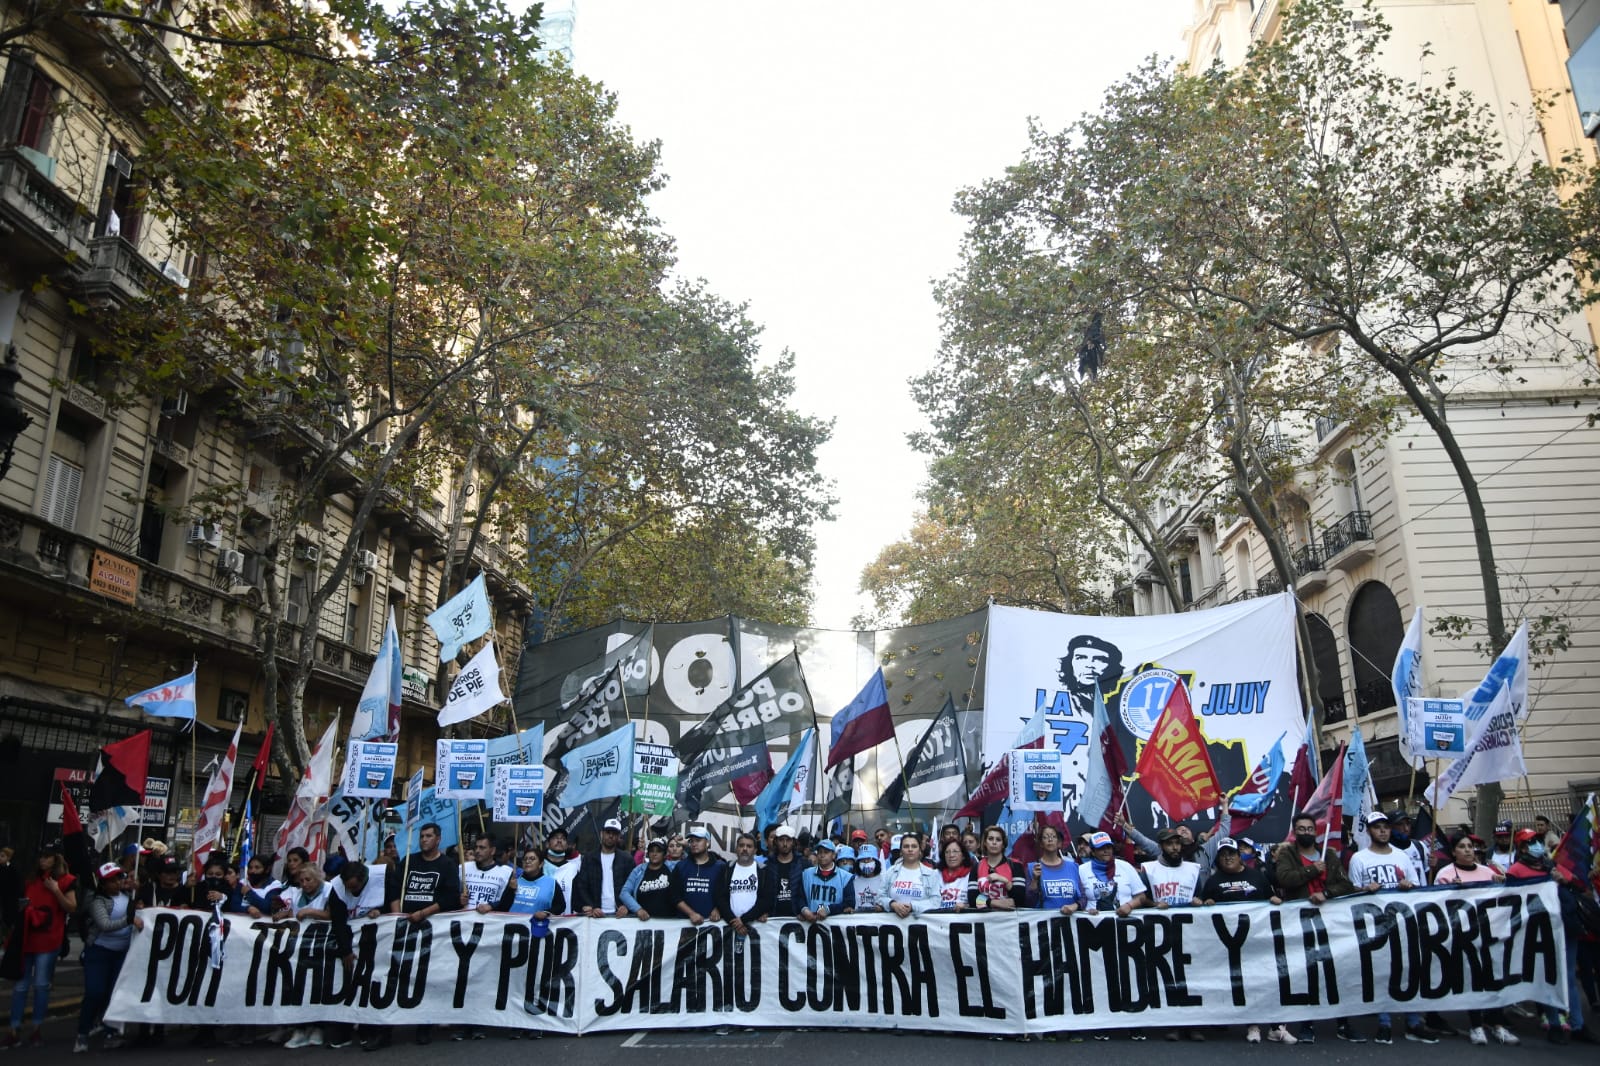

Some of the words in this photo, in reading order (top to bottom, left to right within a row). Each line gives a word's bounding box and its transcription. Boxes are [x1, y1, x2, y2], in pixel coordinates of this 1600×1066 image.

[98, 570, 130, 587] ALQUILA
[448, 686, 466, 703] DE
[465, 676, 484, 695] PIE
[1144, 681, 1170, 710] 17
[1036, 688, 1072, 716] LA
[1202, 680, 1271, 716] JUJUY
[640, 755, 650, 765] NO
[650, 757, 668, 767] PARA
[642, 765, 650, 774] EL
[650, 766, 663, 776] FMI
[145, 780, 168, 791] ARREA
[643, 783, 671, 792] TRIBUNA
[411, 875, 434, 883] BARRIOS
[1367, 864, 1397, 884] FAR
[729, 884, 757, 892] OBRERO
[892, 881, 912, 889] MST
[977, 880, 1008, 900] MST
[1047, 886, 1060, 894] DE
[1153, 882, 1180, 899] MST
[477, 893, 494, 903] PIE
[811, 884, 836, 902] MTR
[940, 888, 960, 901] MST
[140, 913, 231, 1008] POR
[244, 917, 434, 1009] TRABAJO
[449, 920, 485, 1009] Y
[494, 922, 579, 1018] POR
[594, 923, 762, 1017] SALARIO
[778, 921, 940, 1017] CONTRA
[948, 922, 1007, 1019] EL
[1018, 913, 1203, 1020] HAMBRE
[1211, 913, 1250, 1006] Y
[1269, 907, 1341, 1006] LA
[1350, 892, 1559, 1003] POBREZA
